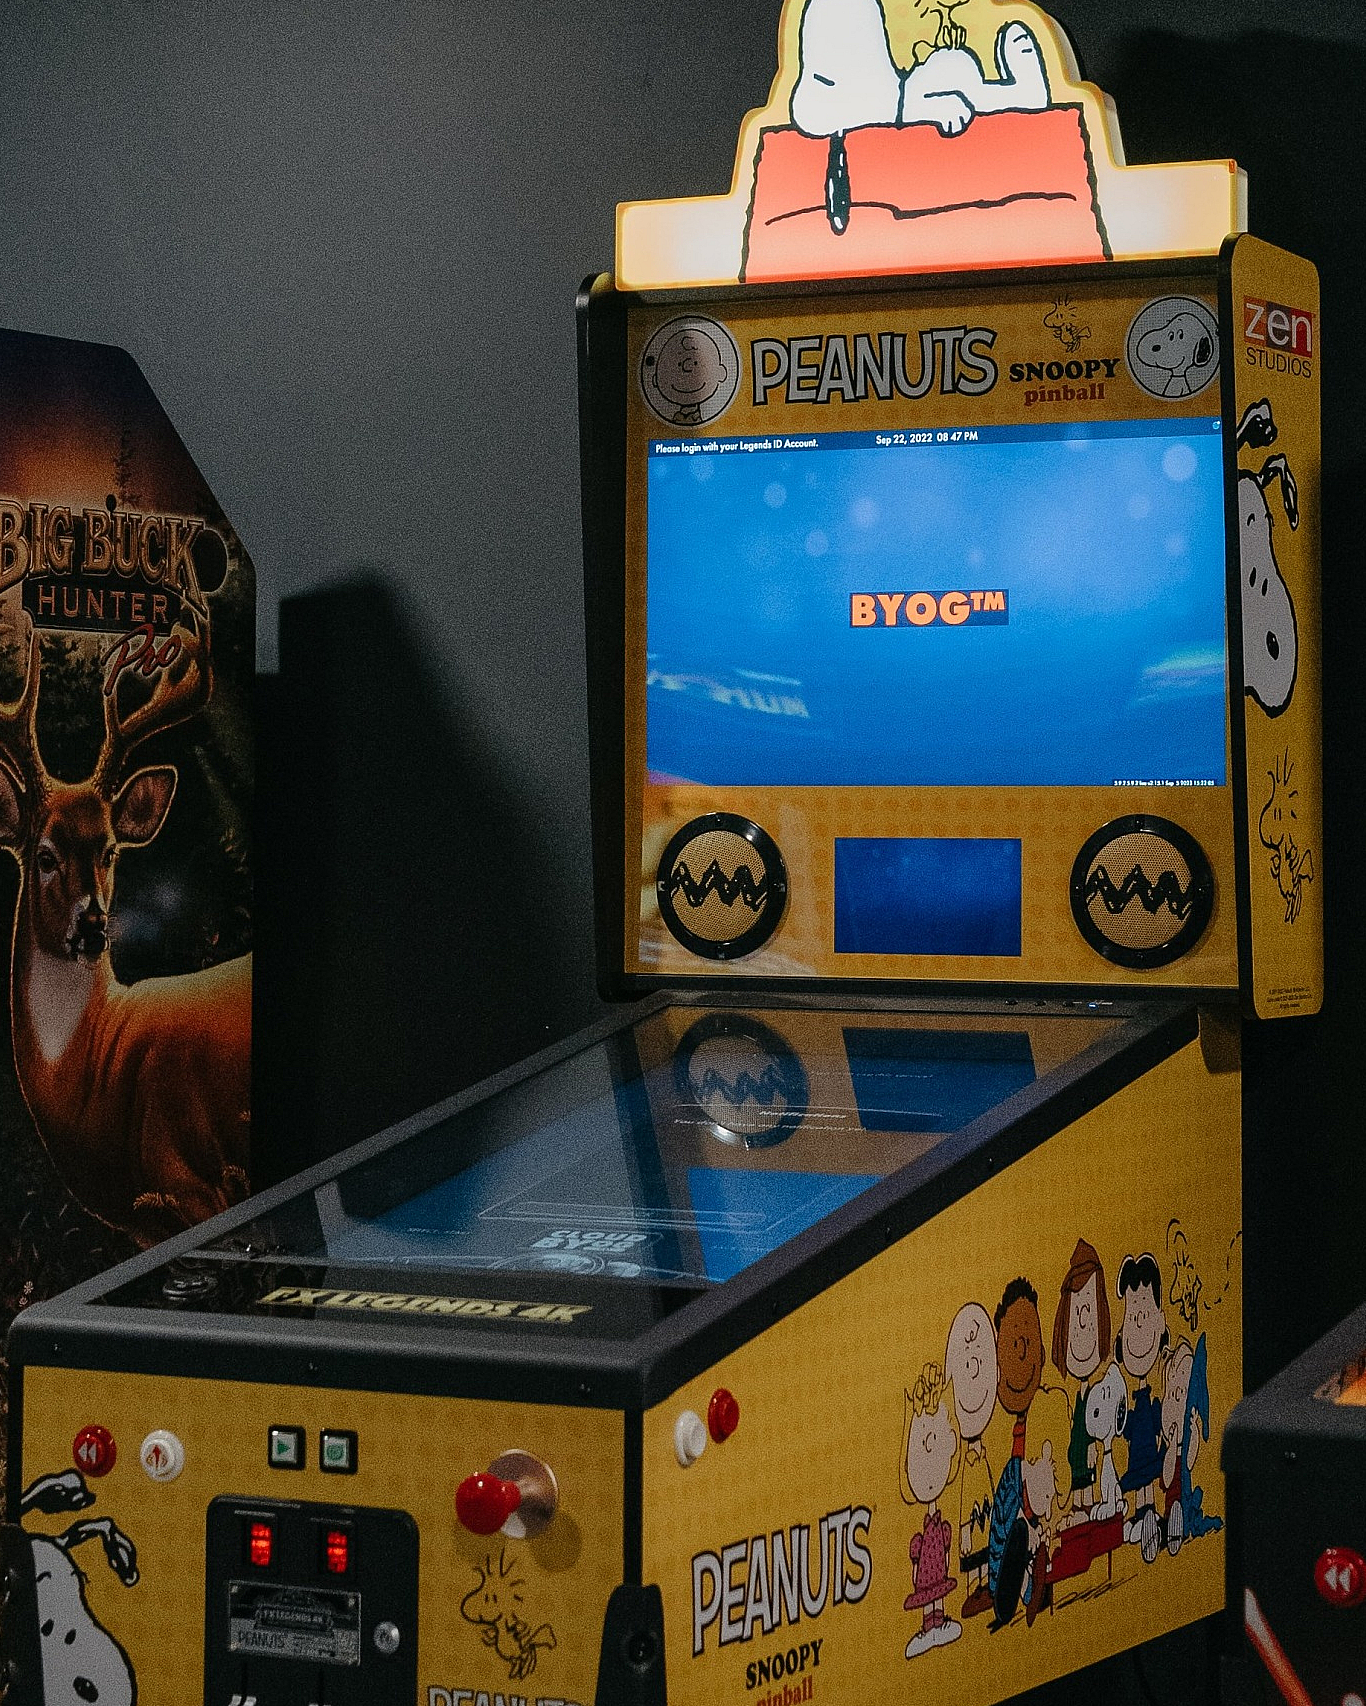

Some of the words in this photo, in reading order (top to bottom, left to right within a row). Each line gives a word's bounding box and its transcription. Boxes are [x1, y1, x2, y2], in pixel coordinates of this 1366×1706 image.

[1245, 301, 1312, 353] zen
[751, 327, 998, 406] PEANUTS
[1010, 358, 1121, 383] SNOOPY
[1246, 351, 1312, 378] STUDIOS
[1024, 383, 1105, 406] pinball
[656, 444, 680, 453] Please
[682, 443, 701, 454] login
[702, 443, 718, 452] with
[720, 444, 738, 453] your
[740, 442, 771, 453] Legends
[774, 440, 782, 449] ID
[784, 439, 818, 449] Account.
[876, 435, 891, 446] Sep
[893, 435, 908, 445] 22,
[910, 433, 932, 444] 2022
[964, 431, 978, 441] PM
[83, 508, 208, 620] BUCK
[38, 585, 168, 624] HUNTER
[101, 623, 182, 696] Pro
[550, 1230, 648, 1242] CLOUD
[691, 1506, 873, 1658] PEANUTS
[745, 1639, 823, 1691] SNOOPY
